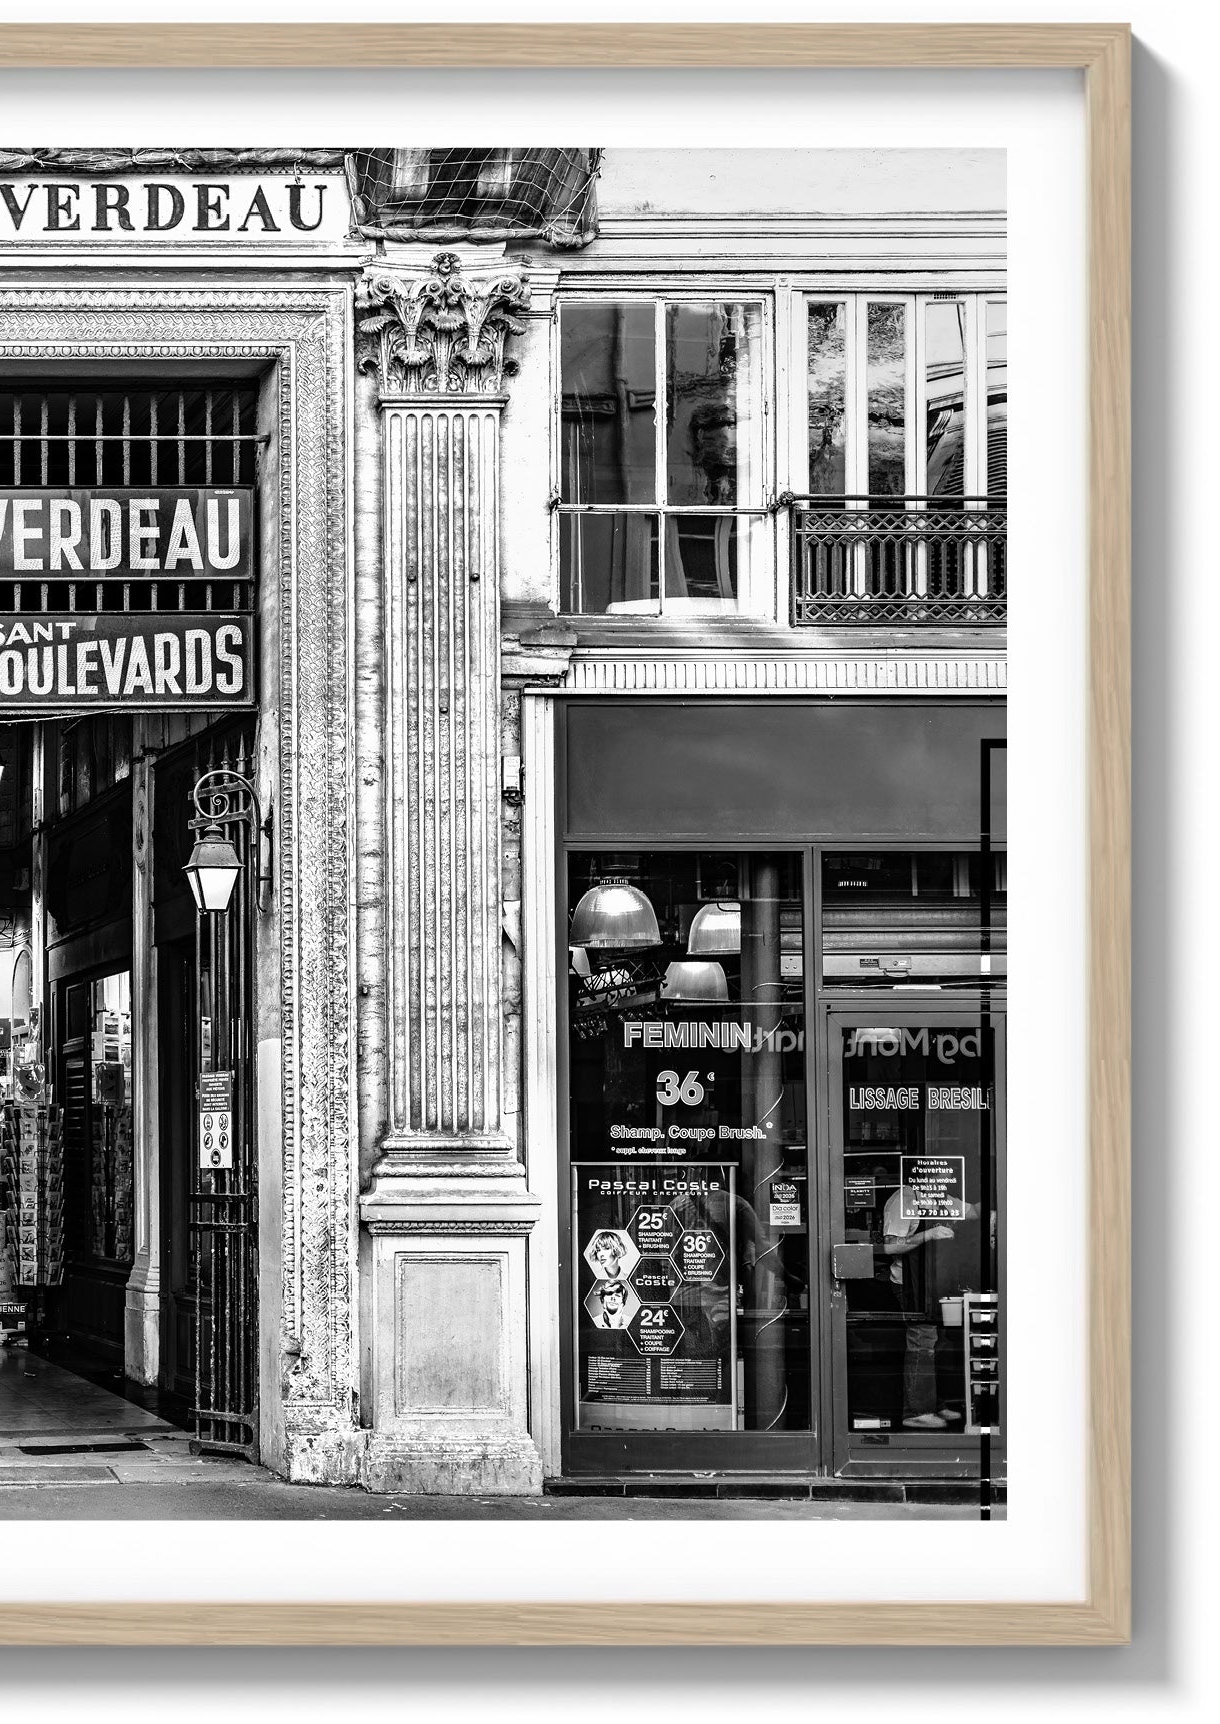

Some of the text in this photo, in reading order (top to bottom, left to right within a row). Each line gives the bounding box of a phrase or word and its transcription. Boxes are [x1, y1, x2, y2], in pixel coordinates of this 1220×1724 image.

[624, 1022, 751, 1048] FEMININ
[849, 1088, 991, 1110] LISSAGE BRESIL
[610, 1125, 665, 1141] Shamp.
[668, 1126, 715, 1141] Coupe
[589, 1179, 720, 1190] Pascal Coste
[638, 1213, 668, 1230] 25€
[683, 1235, 711, 1253] 36€
[640, 1309, 669, 1326] 24€
